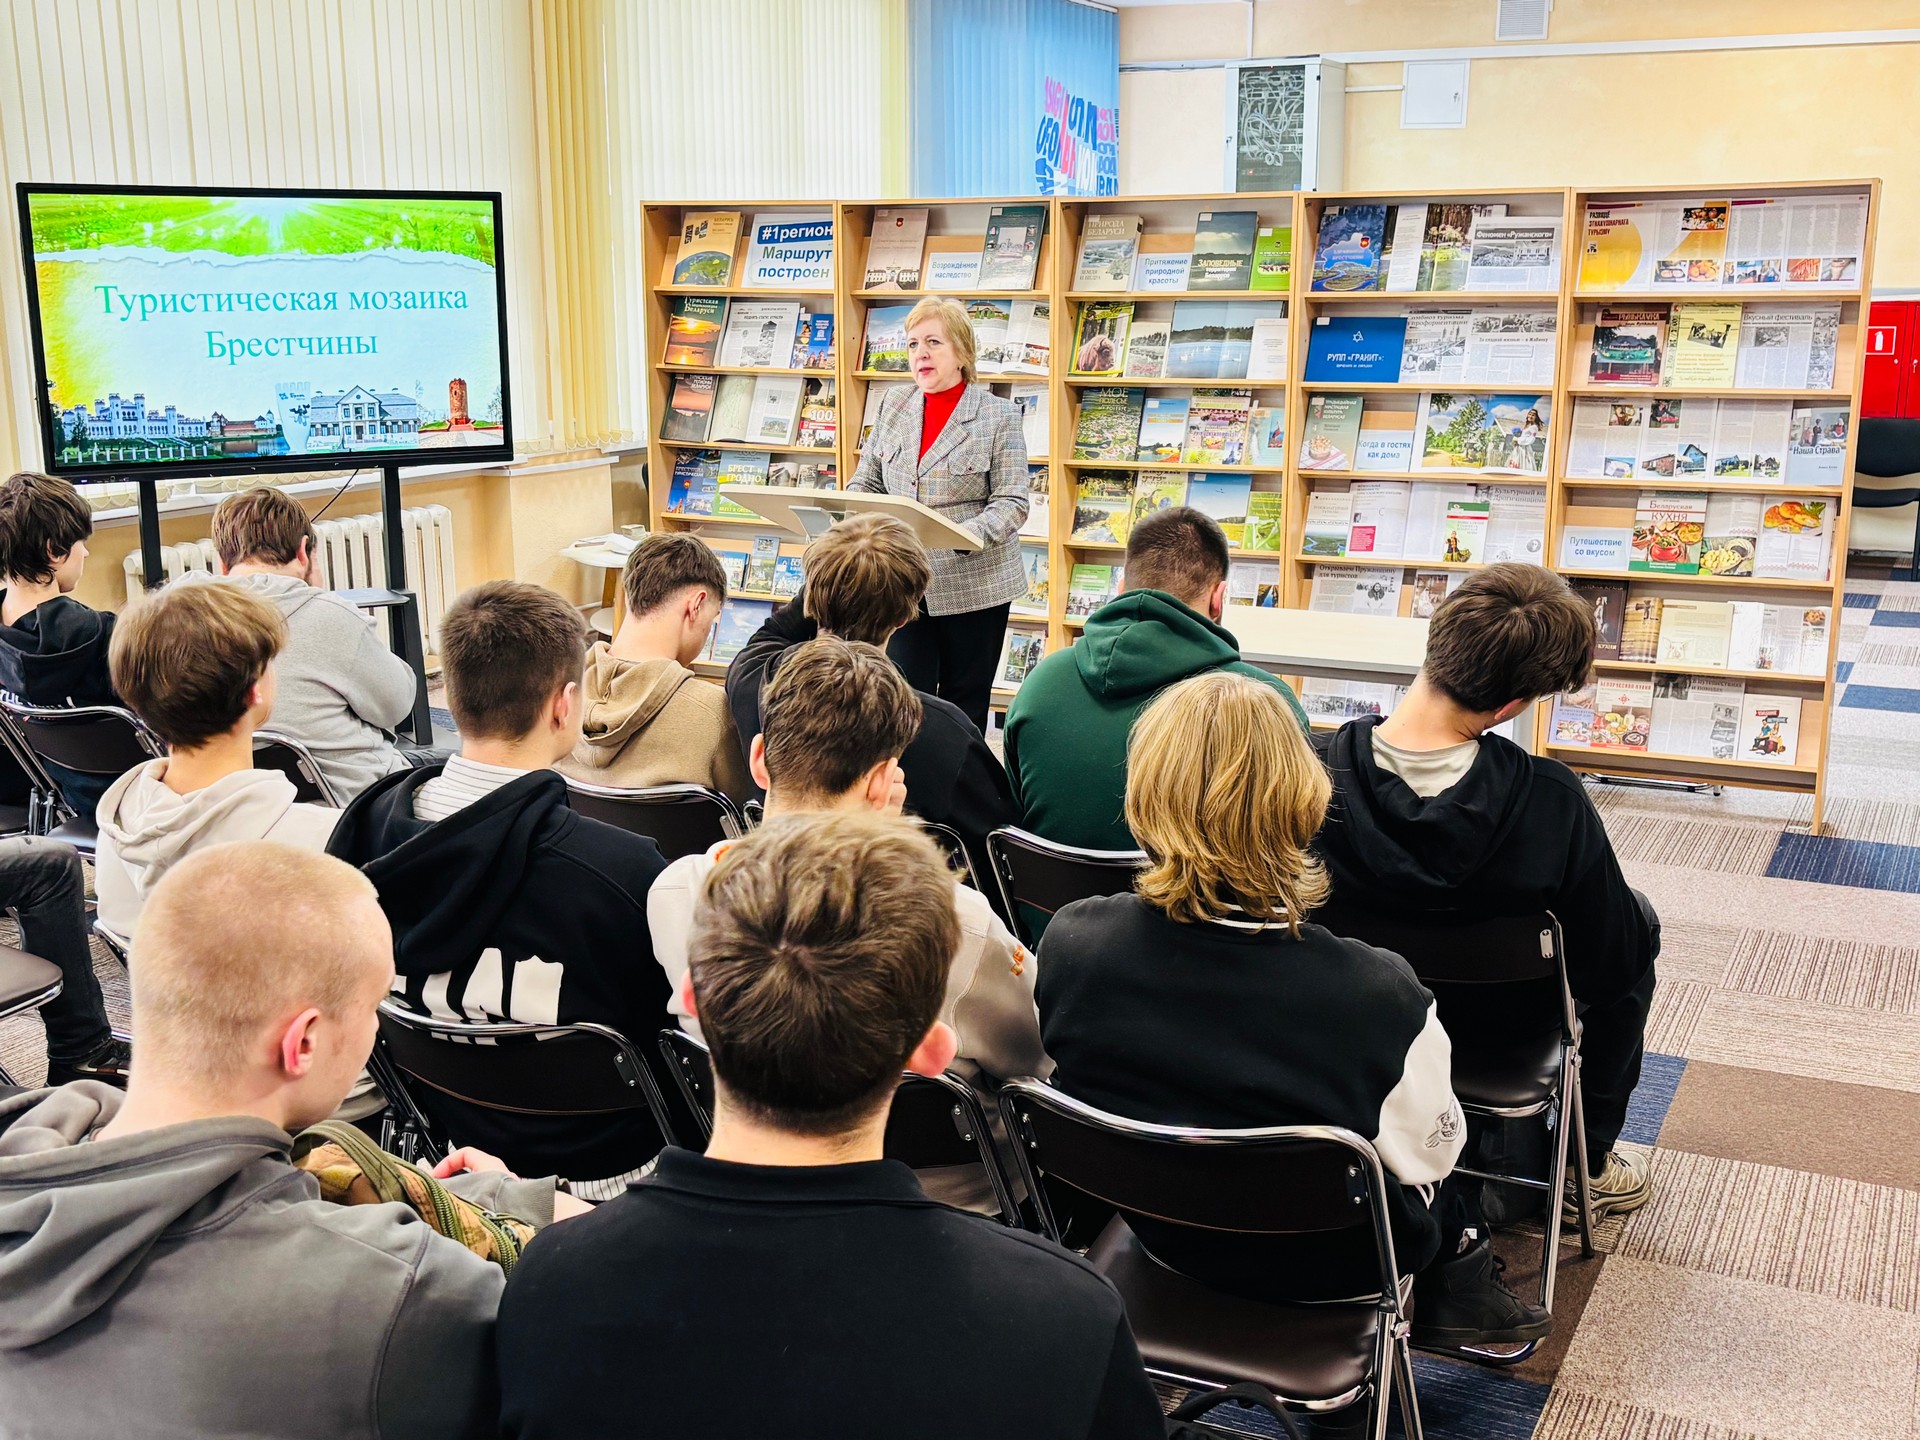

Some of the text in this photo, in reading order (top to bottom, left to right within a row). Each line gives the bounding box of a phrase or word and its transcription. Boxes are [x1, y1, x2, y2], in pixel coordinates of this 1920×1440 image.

[762, 225, 833, 243] #1регион
[1087, 228, 1125, 236] БЕЛАРУСИ
[1476, 230, 1553, 240] Феномен «Ружанского»
[762, 246, 832, 263] Маршрут
[931, 261, 978, 270] Возрождённое
[1144, 258, 1188, 267] Притяжение
[1198, 259, 1244, 267] ЗАПОВЕДНЫЕ
[758, 267, 830, 281] построен
[1145, 268, 1185, 276] природной
[95, 285, 469, 322] Туристическая мозаика
[684, 304, 716, 315] Беларуси
[1743, 313, 1813, 322] Вкусный фестиваль
[203, 330, 379, 365] Брестчины
[1326, 353, 1347, 362] РУПП
[1099, 387, 1129, 397] МОЕ
[810, 409, 834, 421] 100
[1359, 440, 1379, 449] Когда
[1387, 441, 1412, 449] гостях
[1793, 445, 1841, 456] Наша Страва
[727, 464, 754, 474] БРЕСТ
[726, 474, 762, 484] ГРОДНО
[1494, 487, 1535, 497] Культурный
[1651, 512, 1688, 522] КУХНЯ
[1569, 536, 1623, 547] Путешествие
[1574, 548, 1615, 558] со вкусом
[1319, 564, 1355, 573] Открываем
